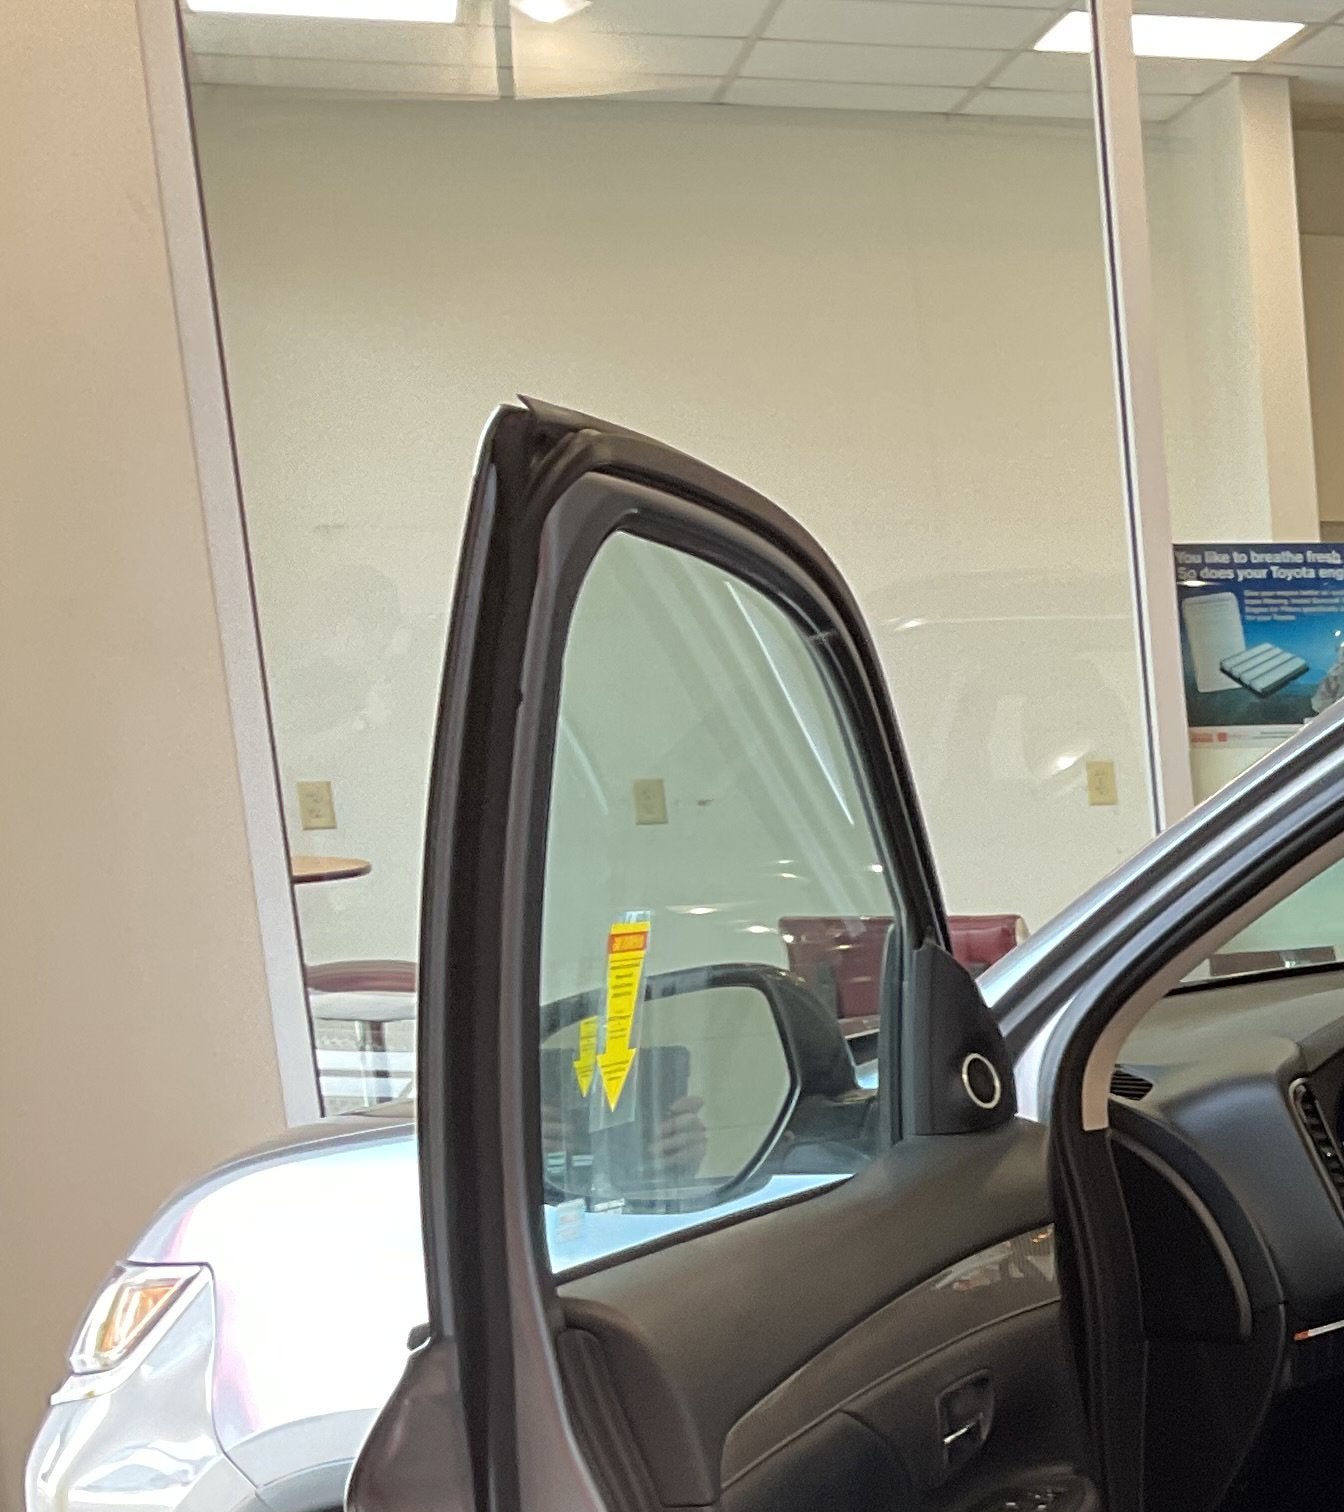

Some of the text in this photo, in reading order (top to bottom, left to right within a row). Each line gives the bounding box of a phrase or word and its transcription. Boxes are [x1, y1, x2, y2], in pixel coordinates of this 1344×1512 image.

[1176, 551, 1201, 563] You
[1204, 550, 1230, 564] like
[1232, 551, 1248, 564] to
[1250, 550, 1304, 564] breathe
[1306, 550, 1342, 564] fresh
[1177, 566, 1198, 580] So
[1199, 566, 1234, 580] does
[1237, 567, 1269, 581] your
[1270, 566, 1316, 581] Toyota
